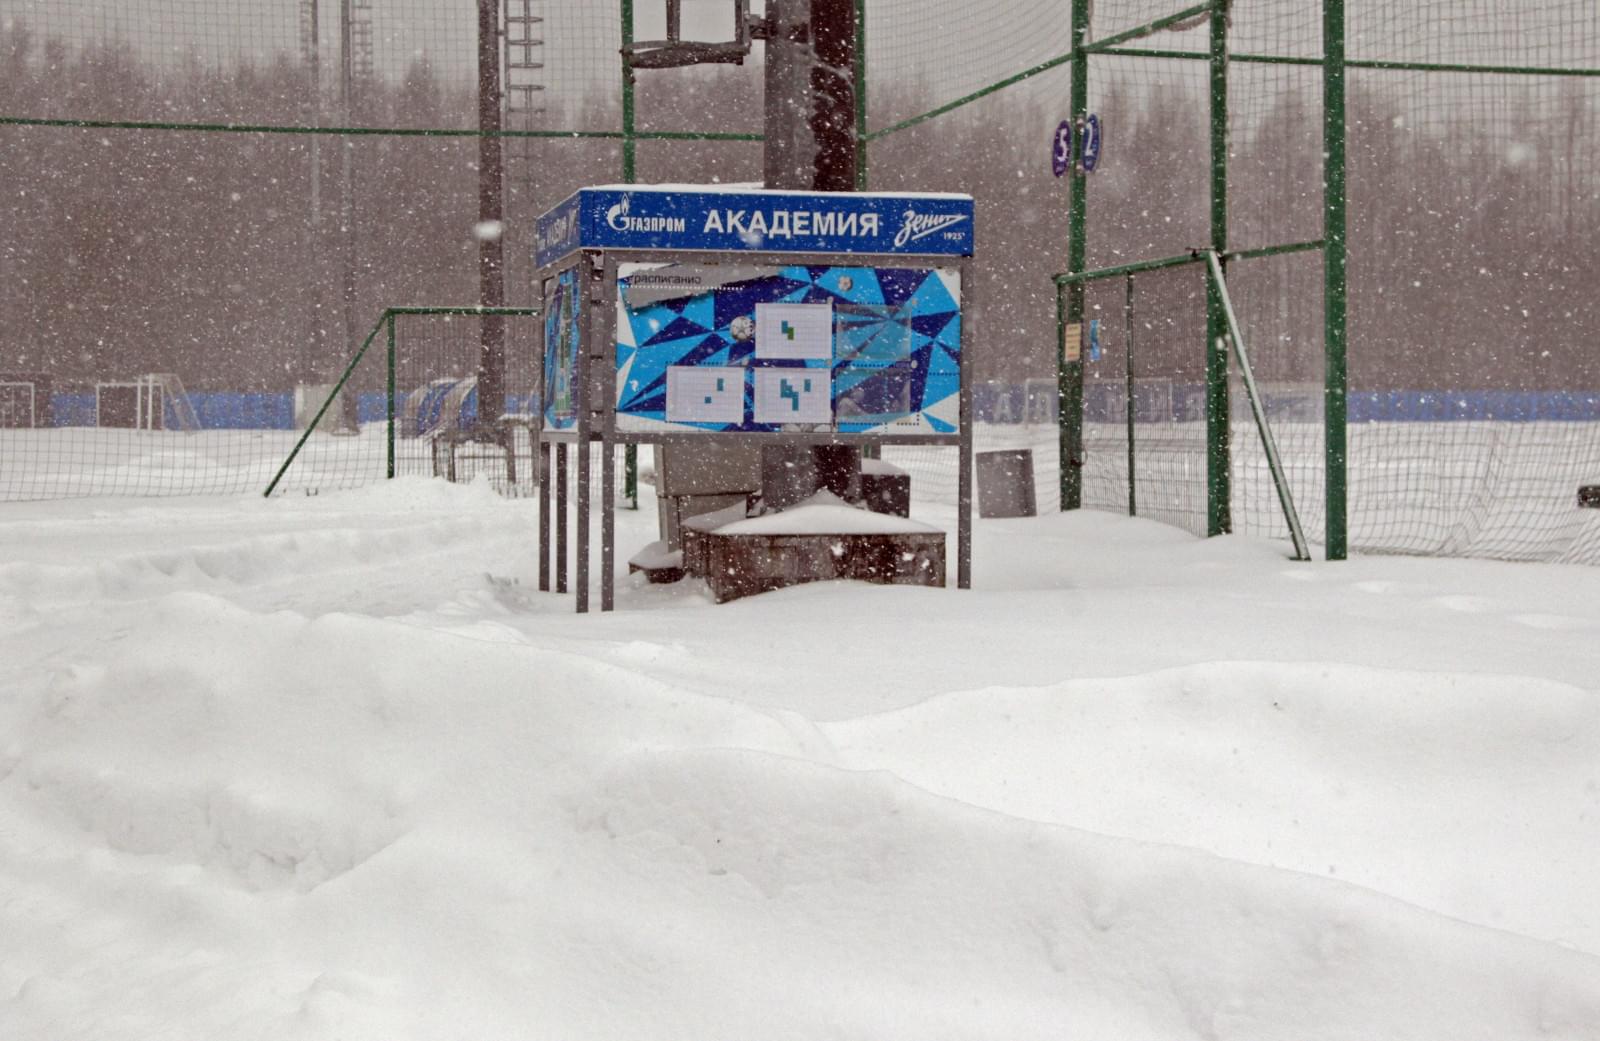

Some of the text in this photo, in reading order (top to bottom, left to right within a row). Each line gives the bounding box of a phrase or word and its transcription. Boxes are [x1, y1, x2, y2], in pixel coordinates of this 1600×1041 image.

[1085, 122, 1094, 156] 2
[631, 217, 685, 232] ГАЗПРОМ
[703, 209, 878, 239] АКАДЕМИЯ
